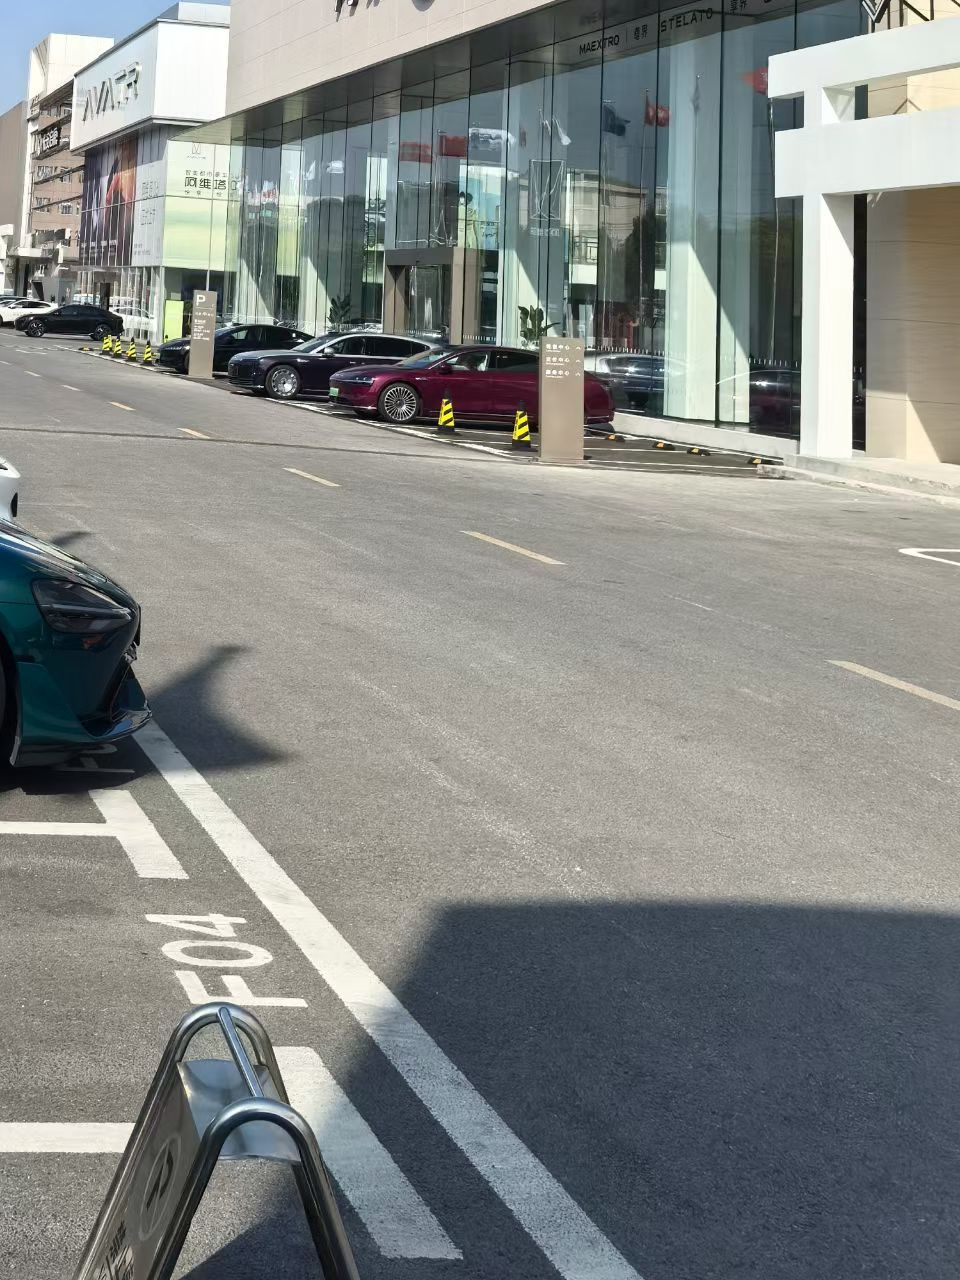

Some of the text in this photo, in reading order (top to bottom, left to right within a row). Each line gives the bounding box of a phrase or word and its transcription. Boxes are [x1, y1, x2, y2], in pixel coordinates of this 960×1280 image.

[660, 7, 713, 33] STELATO
[579, 34, 620, 56] MAEXTRO
[195, 294, 206, 307] P
[145, 912, 309, 1008] F04
